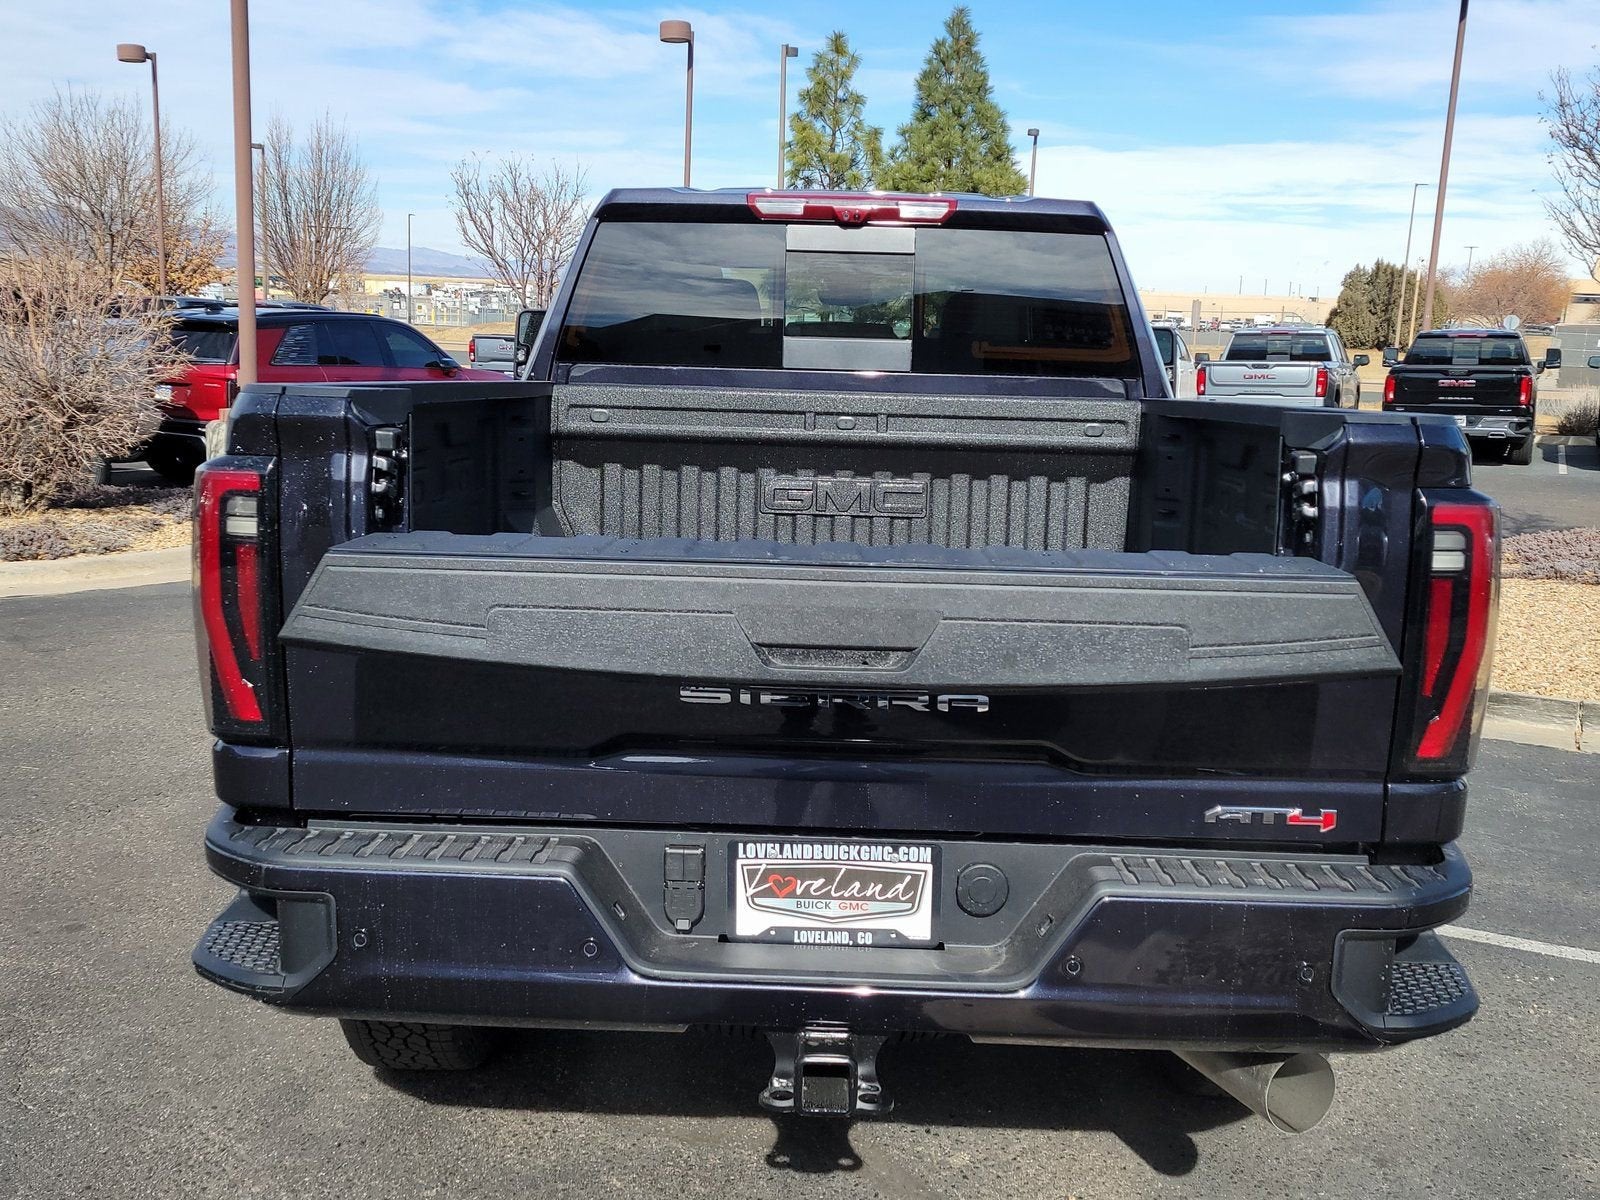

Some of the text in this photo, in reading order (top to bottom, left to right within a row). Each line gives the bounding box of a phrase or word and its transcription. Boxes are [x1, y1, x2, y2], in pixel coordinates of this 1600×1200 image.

[1438, 379, 1476, 388] GMC
[763, 479, 926, 515] GMC
[679, 686, 989, 713] SIERRA
[1204, 805, 1338, 833] AT4
[738, 842, 932, 863] LOVELANDBUICKGMC.COM
[796, 900, 870, 912] BUICK GMC
[794, 930, 873, 946] LOVELAND, CO
